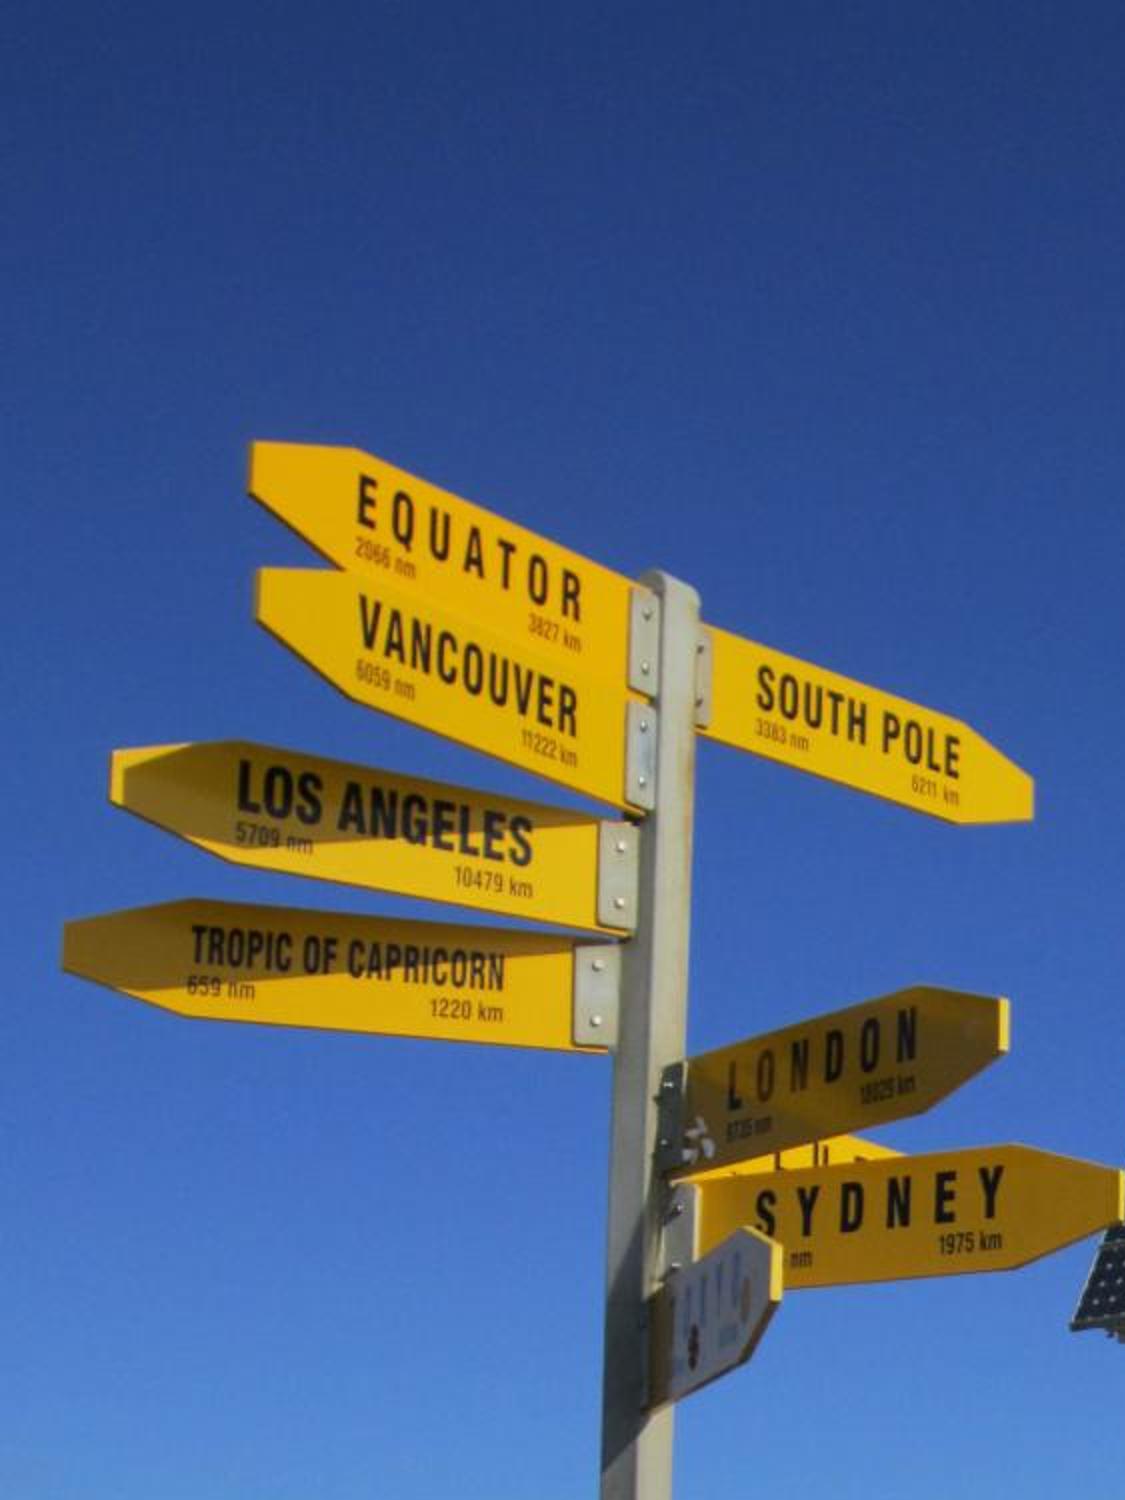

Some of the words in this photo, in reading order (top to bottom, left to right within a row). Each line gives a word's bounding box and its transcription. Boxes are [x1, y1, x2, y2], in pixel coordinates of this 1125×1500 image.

[357, 473, 581, 623] EQUATOR
[395, 556, 416, 579] nm
[528, 612, 559, 642] 3827
[563, 627, 582, 653] km
[359, 594, 577, 737] VANCOUVER
[395, 678, 416, 702] nm
[756, 664, 867, 746] SOUTH
[881, 710, 960, 779] POLE
[521, 728, 557, 761] 11222
[560, 743, 578, 770] km
[790, 733, 809, 752] nm
[943, 783, 961, 807] km
[238, 759, 323, 825] LOS
[337, 779, 533, 868] ANGELES
[236, 821, 280, 849] 5709
[287, 836, 314, 856] nm
[455, 865, 503, 894] 10479
[509, 876, 534, 899] km
[191, 924, 292, 973] TROPIC
[303, 935, 339, 975] OF
[347, 939, 505, 992] CAPRICORN
[186, 974, 222, 998] 659
[228, 981, 256, 1001] nm
[430, 998, 473, 1022] 1220
[478, 1002, 505, 1023] km
[727, 1006, 918, 1111] LONDON
[755, 1165, 1005, 1237] SYDNEY
[789, 1252, 813, 1269] nm
[938, 1231, 975, 1256] 1975
[979, 1230, 1004, 1250] km
